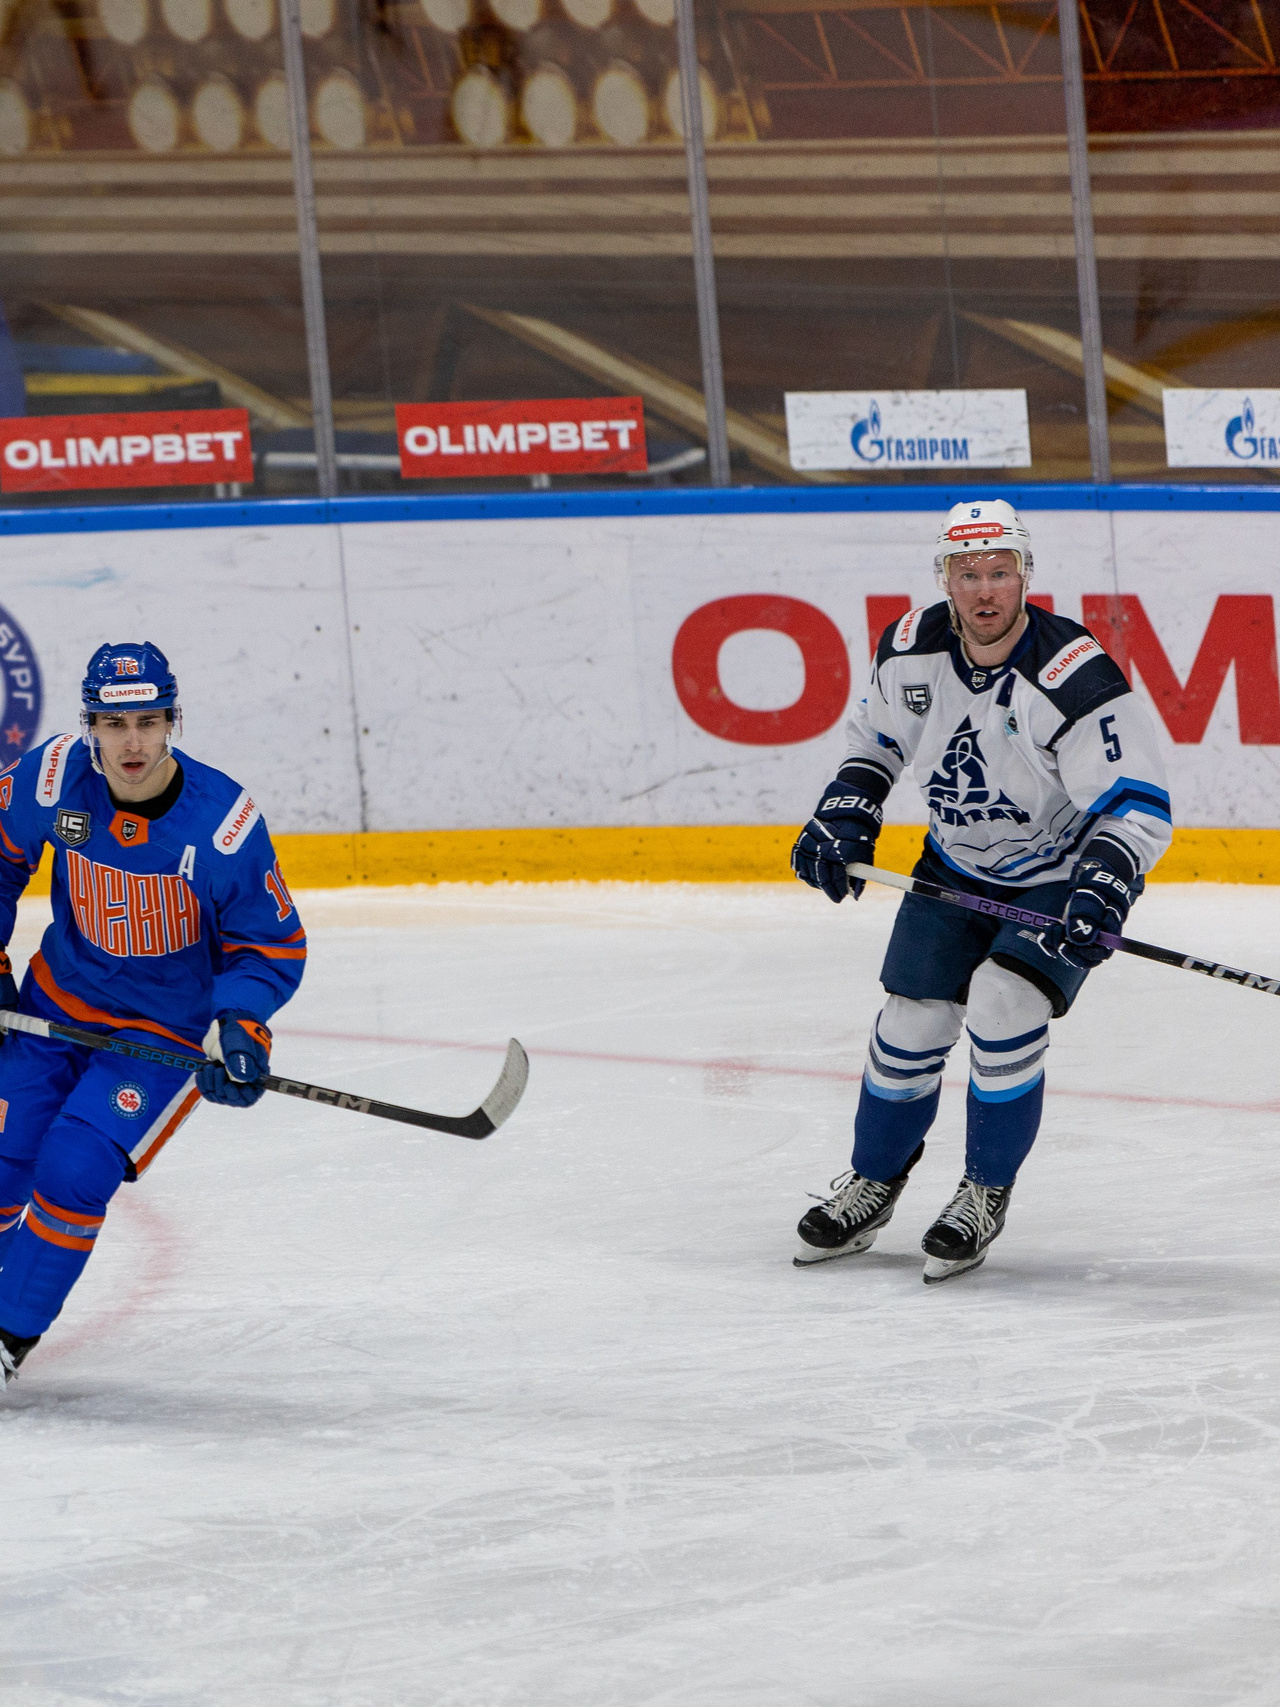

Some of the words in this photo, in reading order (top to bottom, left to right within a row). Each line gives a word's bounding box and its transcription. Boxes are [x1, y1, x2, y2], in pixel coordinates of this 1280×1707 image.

[4, 432, 243, 469] OLIMPBET
[404, 420, 637, 455] OLIMPBET
[887, 438, 969, 461] ГАЗПРОМ
[970, 507, 981, 518] 5
[951, 526, 1001, 537] OLIMPBET
[115, 660, 139, 676] 16
[1046, 640, 1097, 681] OLIMPBET
[103, 688, 154, 698] OLIMPBET
[1099, 714, 1122, 762] 5
[44, 734, 73, 798] OLIMPBET
[178, 845, 196, 880] A
[66, 849, 201, 957] НЕВА
[1181, 956, 1280, 995] CCM
[102, 1041, 198, 1072] JETSPEED
[239, 1054, 247, 1074] CCM
[278, 1079, 371, 1114] CCM
